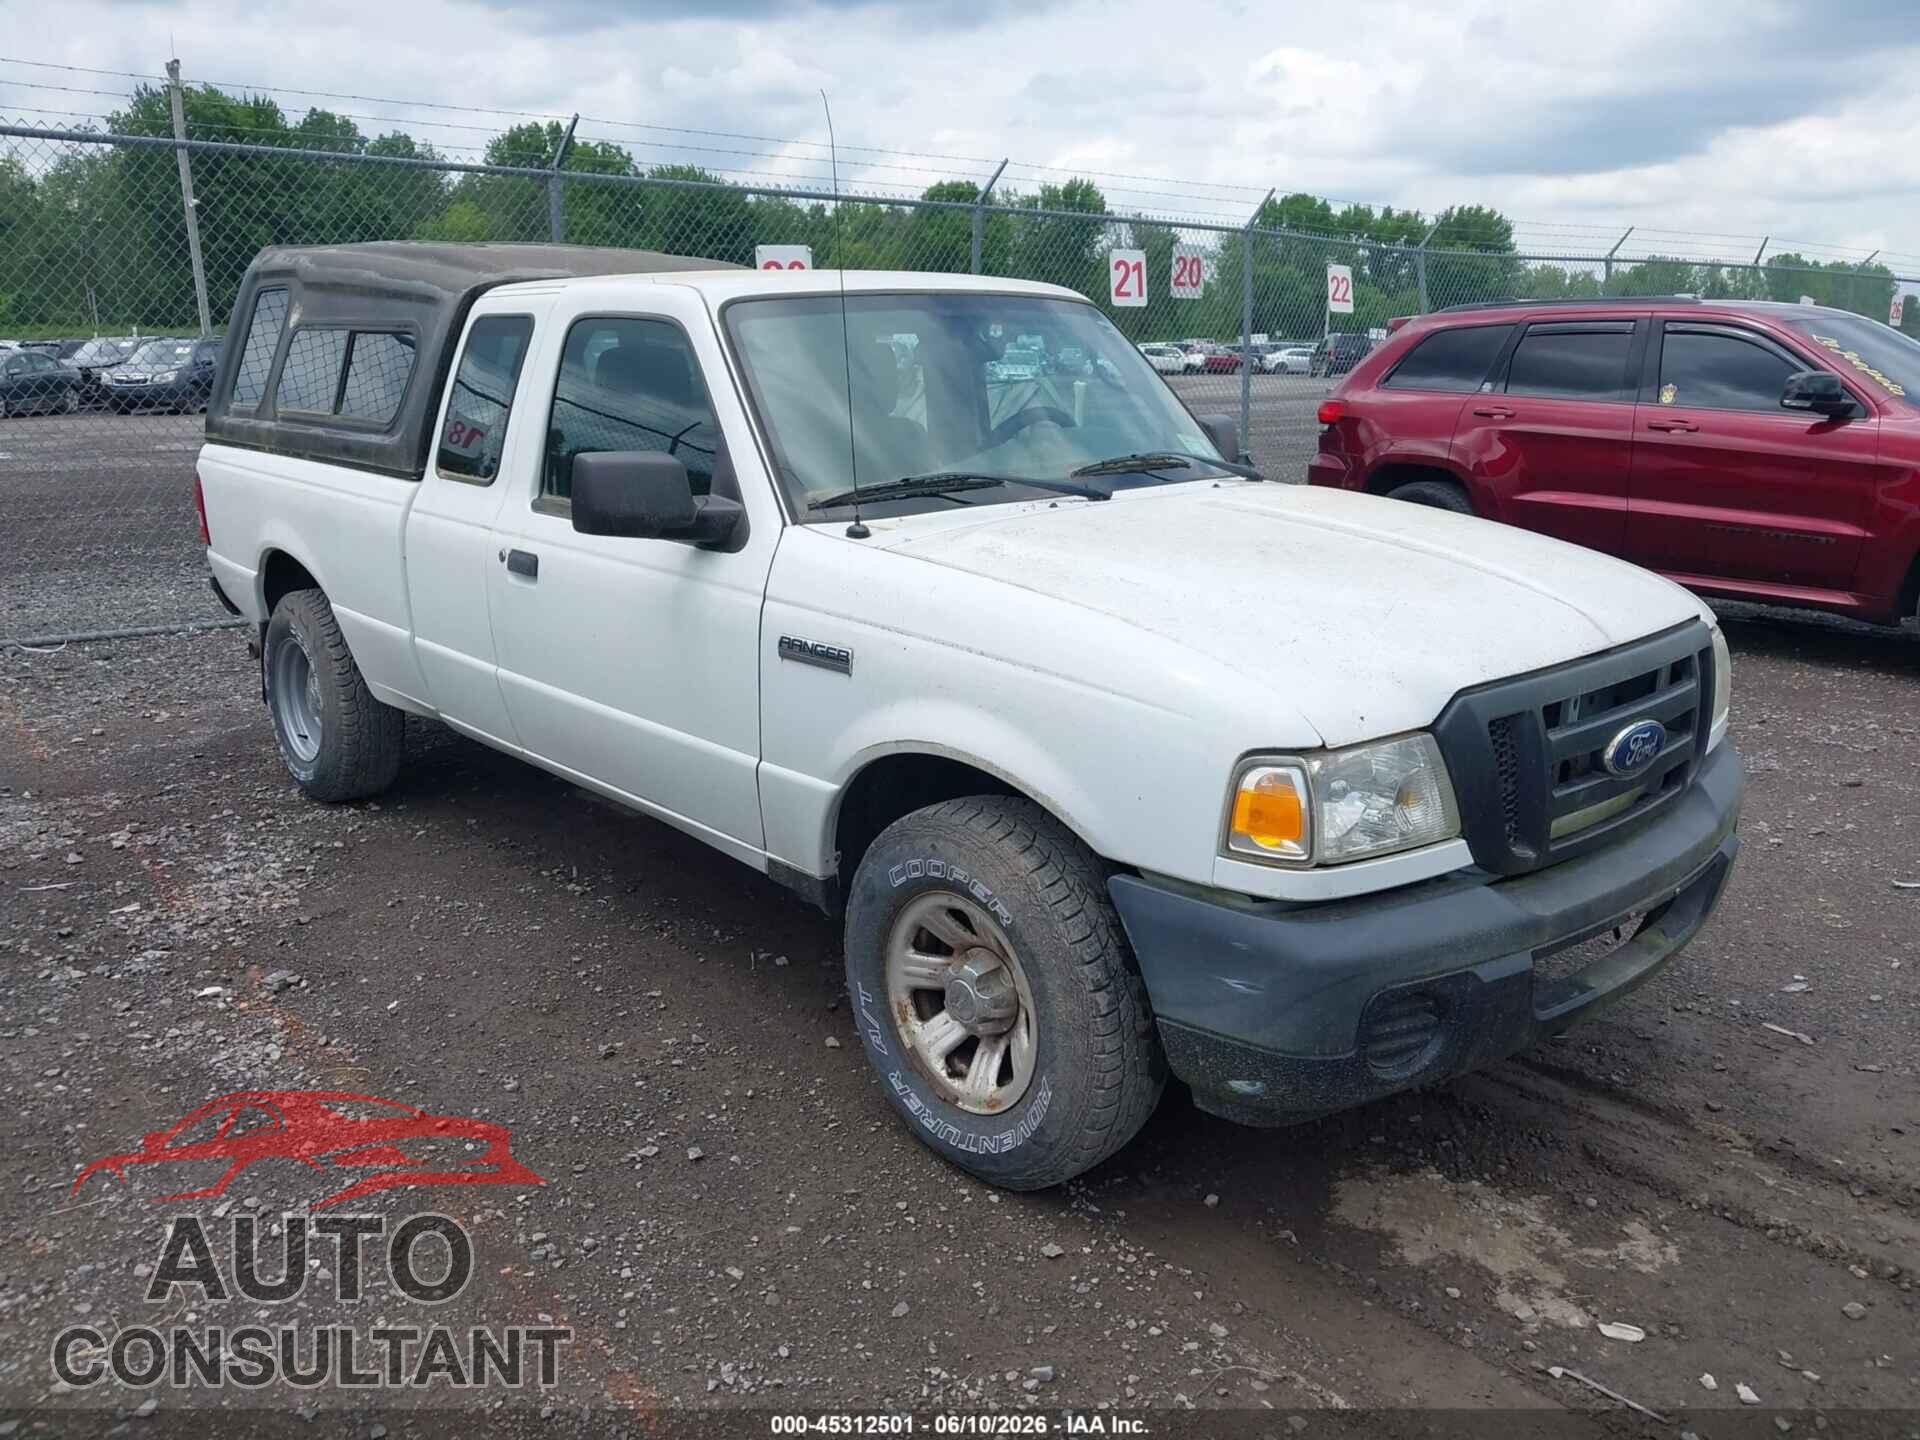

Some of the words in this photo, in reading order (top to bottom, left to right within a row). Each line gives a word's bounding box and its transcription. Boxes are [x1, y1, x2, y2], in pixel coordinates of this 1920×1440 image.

[1114, 260, 1144, 297] 21
[1174, 256, 1201, 288] 20
[1331, 276, 1351, 303] 22
[779, 635, 850, 663] RANGER
[1626, 732, 1659, 766] Ford
[889, 859, 1012, 926] COOPER
[856, 981, 889, 1056] A/T
[888, 1070, 1053, 1154] ADVENTURER
